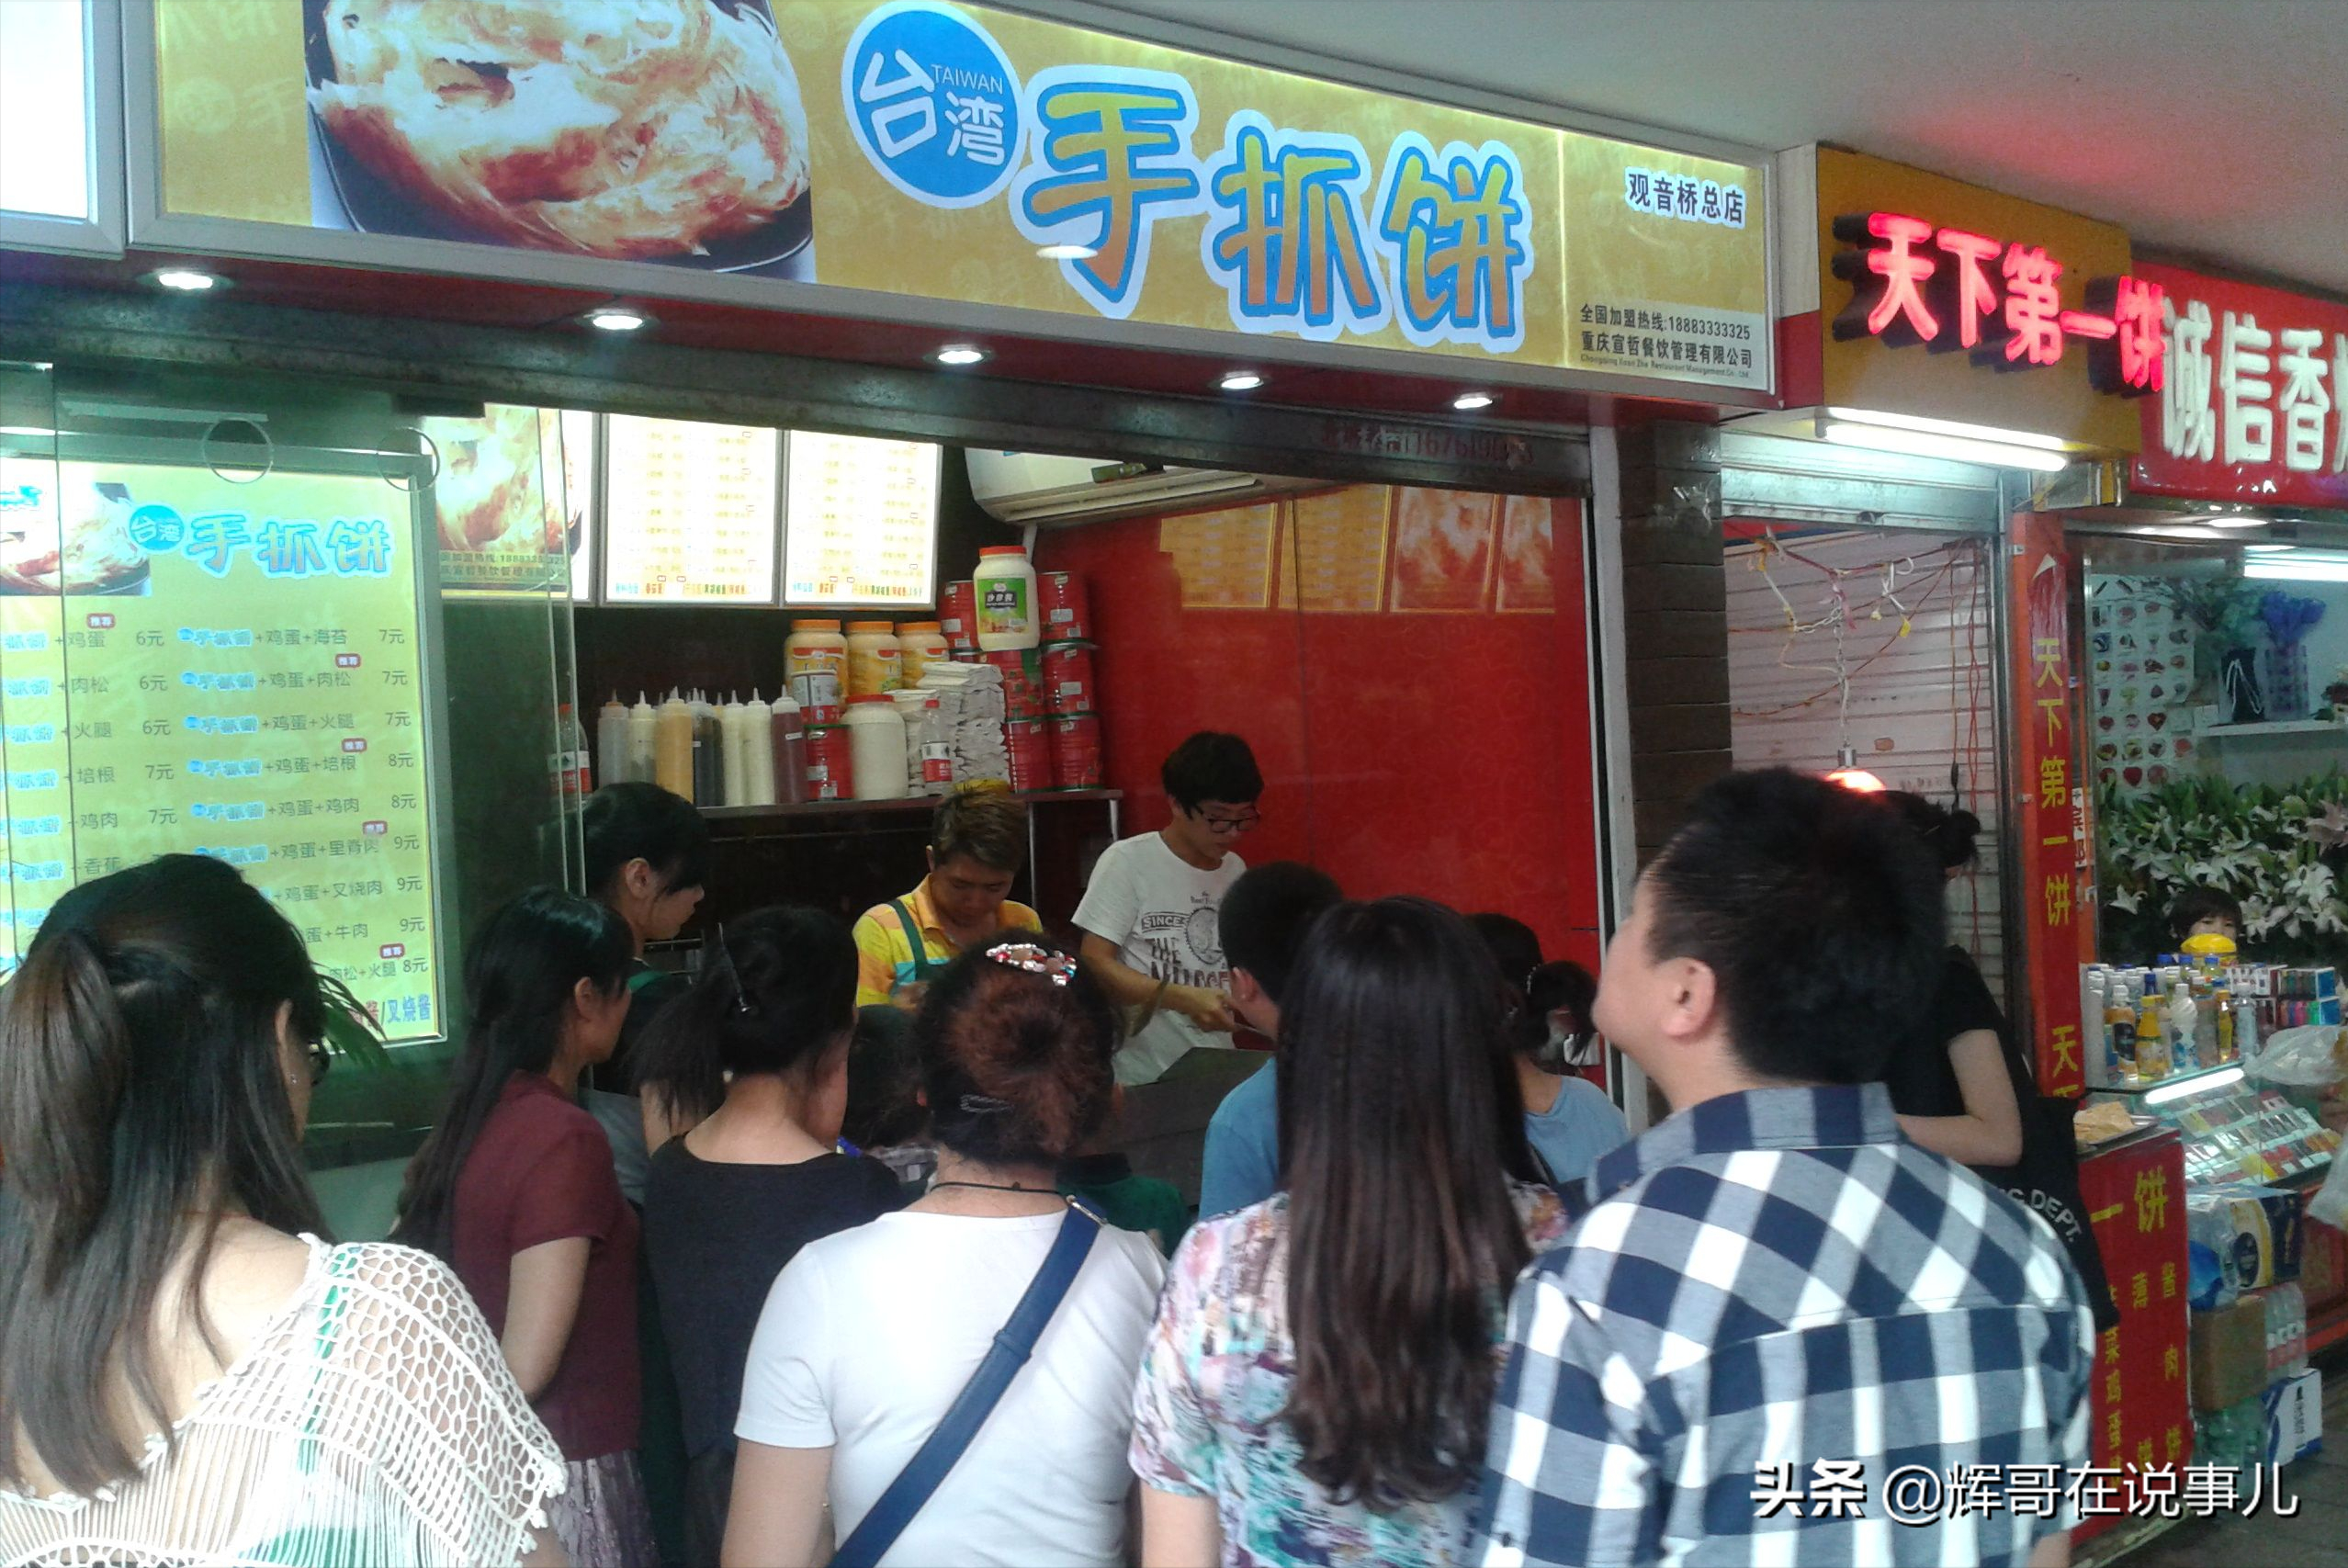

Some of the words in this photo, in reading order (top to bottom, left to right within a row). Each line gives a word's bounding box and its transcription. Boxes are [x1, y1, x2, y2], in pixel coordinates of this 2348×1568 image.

[931, 63, 1004, 96] TAIWAN
[860, 49, 1005, 166] 台湾
[1628, 173, 1744, 224] 观音桥总店
[1020, 80, 1527, 337] 手抓饼
[1868, 211, 2166, 393] 天下第一饼
[186, 513, 391, 574] 手抓饼
[136, 630, 165, 647] 6元
[378, 628, 406, 644] 7元
[140, 674, 168, 691] 6元
[382, 671, 409, 686] 7元
[142, 719, 172, 736] 6元
[386, 712, 412, 728] 7元
[389, 753, 414, 769] 8元
[145, 764, 175, 781] 7元
[2036, 637, 2071, 927] 天下第一饼
[391, 794, 417, 810] 8元
[149, 808, 178, 825] 7元
[394, 835, 420, 852] 9元
[397, 876, 423, 892] 9元
[299, 923, 368, 943] 蛋+牛肉
[400, 917, 425, 933] 9元
[402, 957, 429, 974] 8元
[2029, 1188, 2082, 1243] DEPT.
